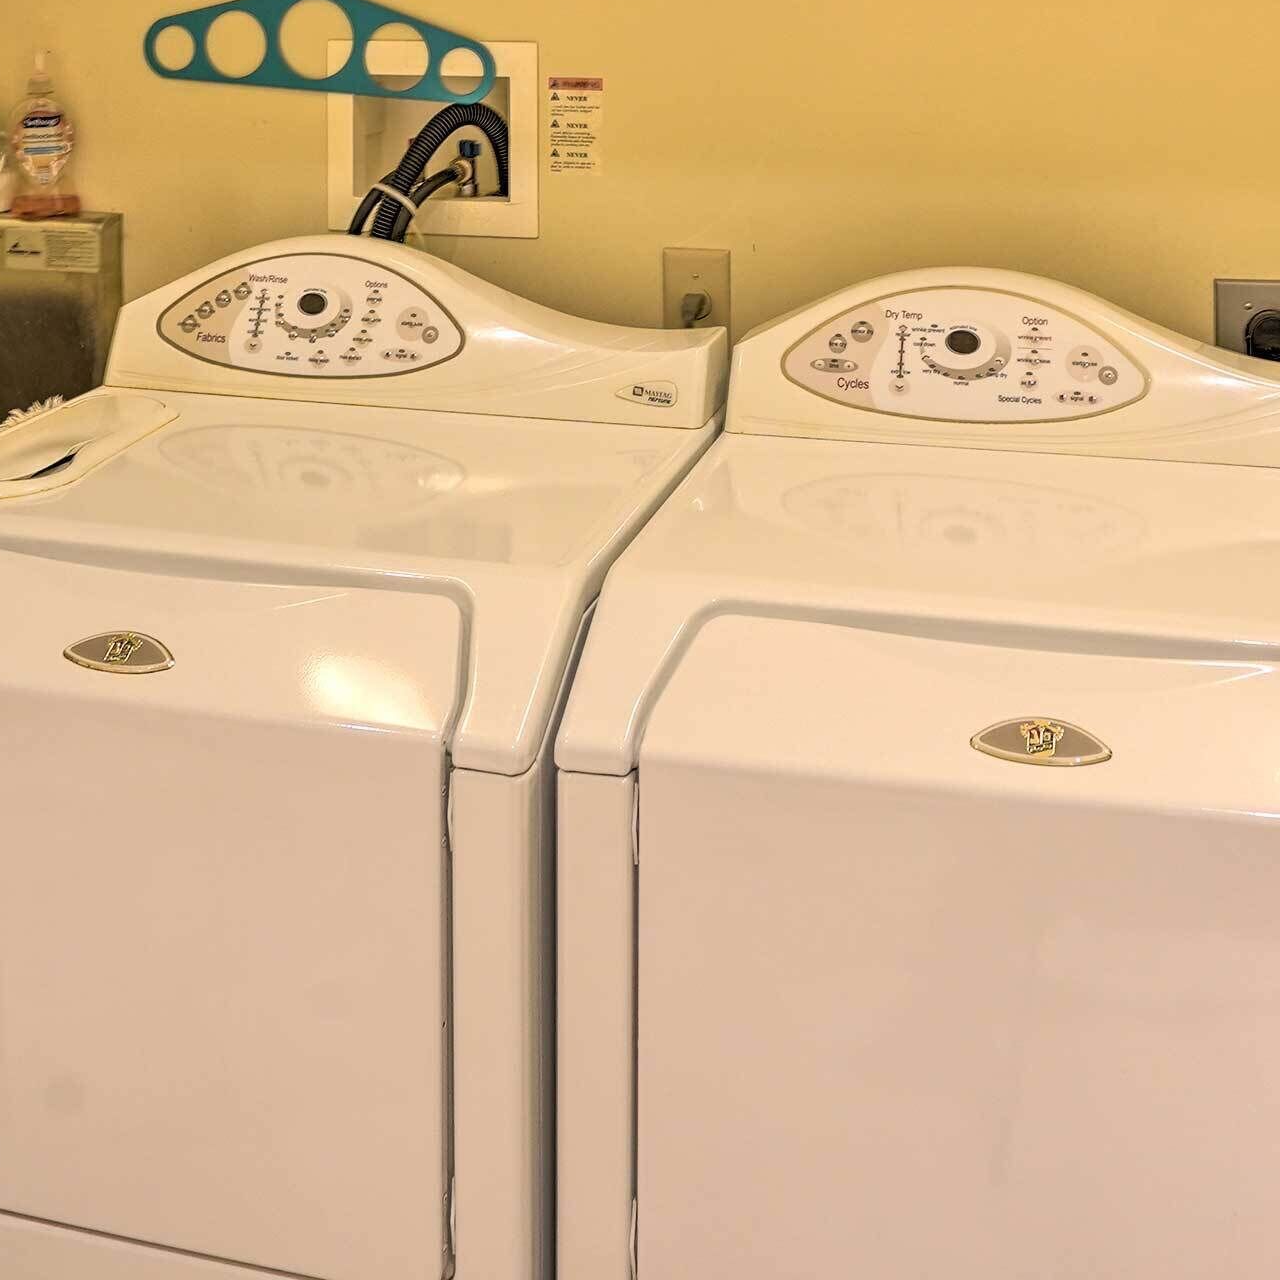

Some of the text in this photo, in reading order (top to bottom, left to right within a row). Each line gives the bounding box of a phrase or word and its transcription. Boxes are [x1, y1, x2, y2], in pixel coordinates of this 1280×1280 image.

[365, 280, 388, 289] Options
[885, 309, 923, 320] Dry Temp
[1022, 316, 1048, 326] Option
[196, 331, 226, 343] Fabrics
[837, 377, 869, 390] Cycles
[645, 389, 672, 399] MAYTAG
[998, 395, 1042, 405] Special Cycles
